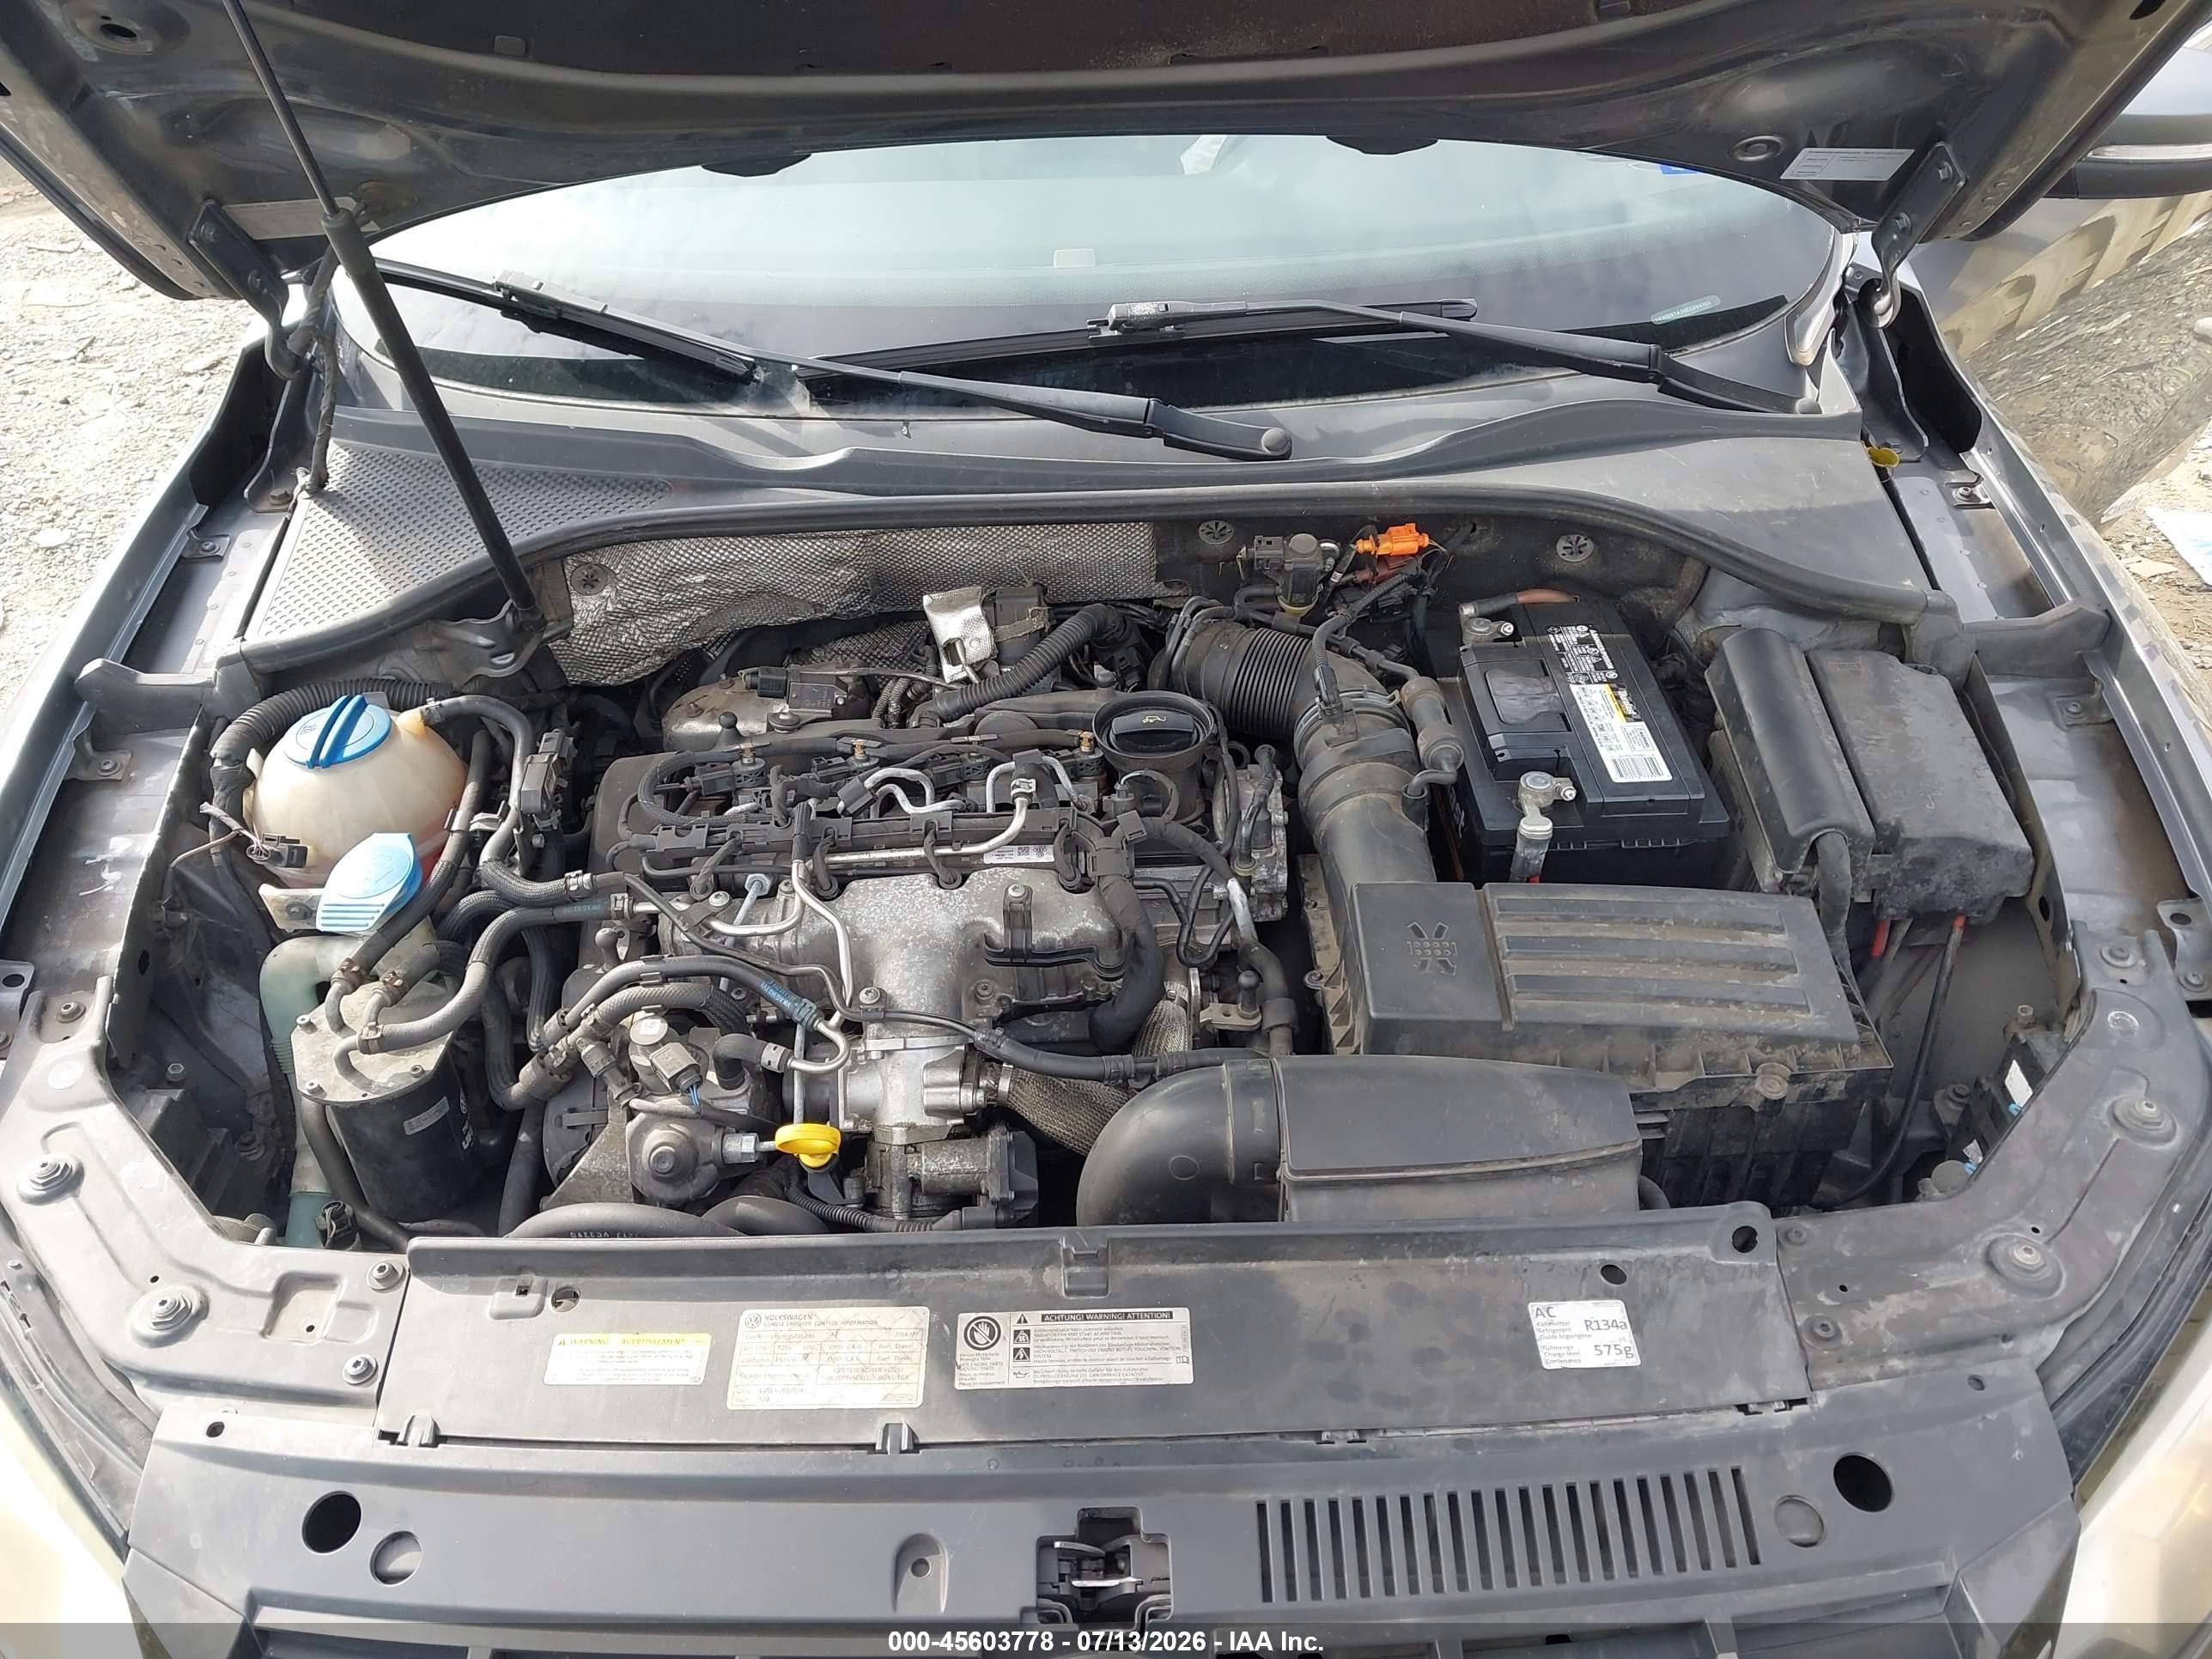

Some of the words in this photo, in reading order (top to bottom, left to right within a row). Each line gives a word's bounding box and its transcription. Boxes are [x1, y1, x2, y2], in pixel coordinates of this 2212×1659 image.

[1044, 1314, 1084, 1322] ACHTUNG!
[1086, 1312, 1125, 1321] WARNING!
[1127, 1311, 1170, 1320] ATTENTION!
[1535, 1306, 1556, 1318] AC
[1584, 1319, 1627, 1331] R134a
[1594, 1344, 1634, 1358] 575g
